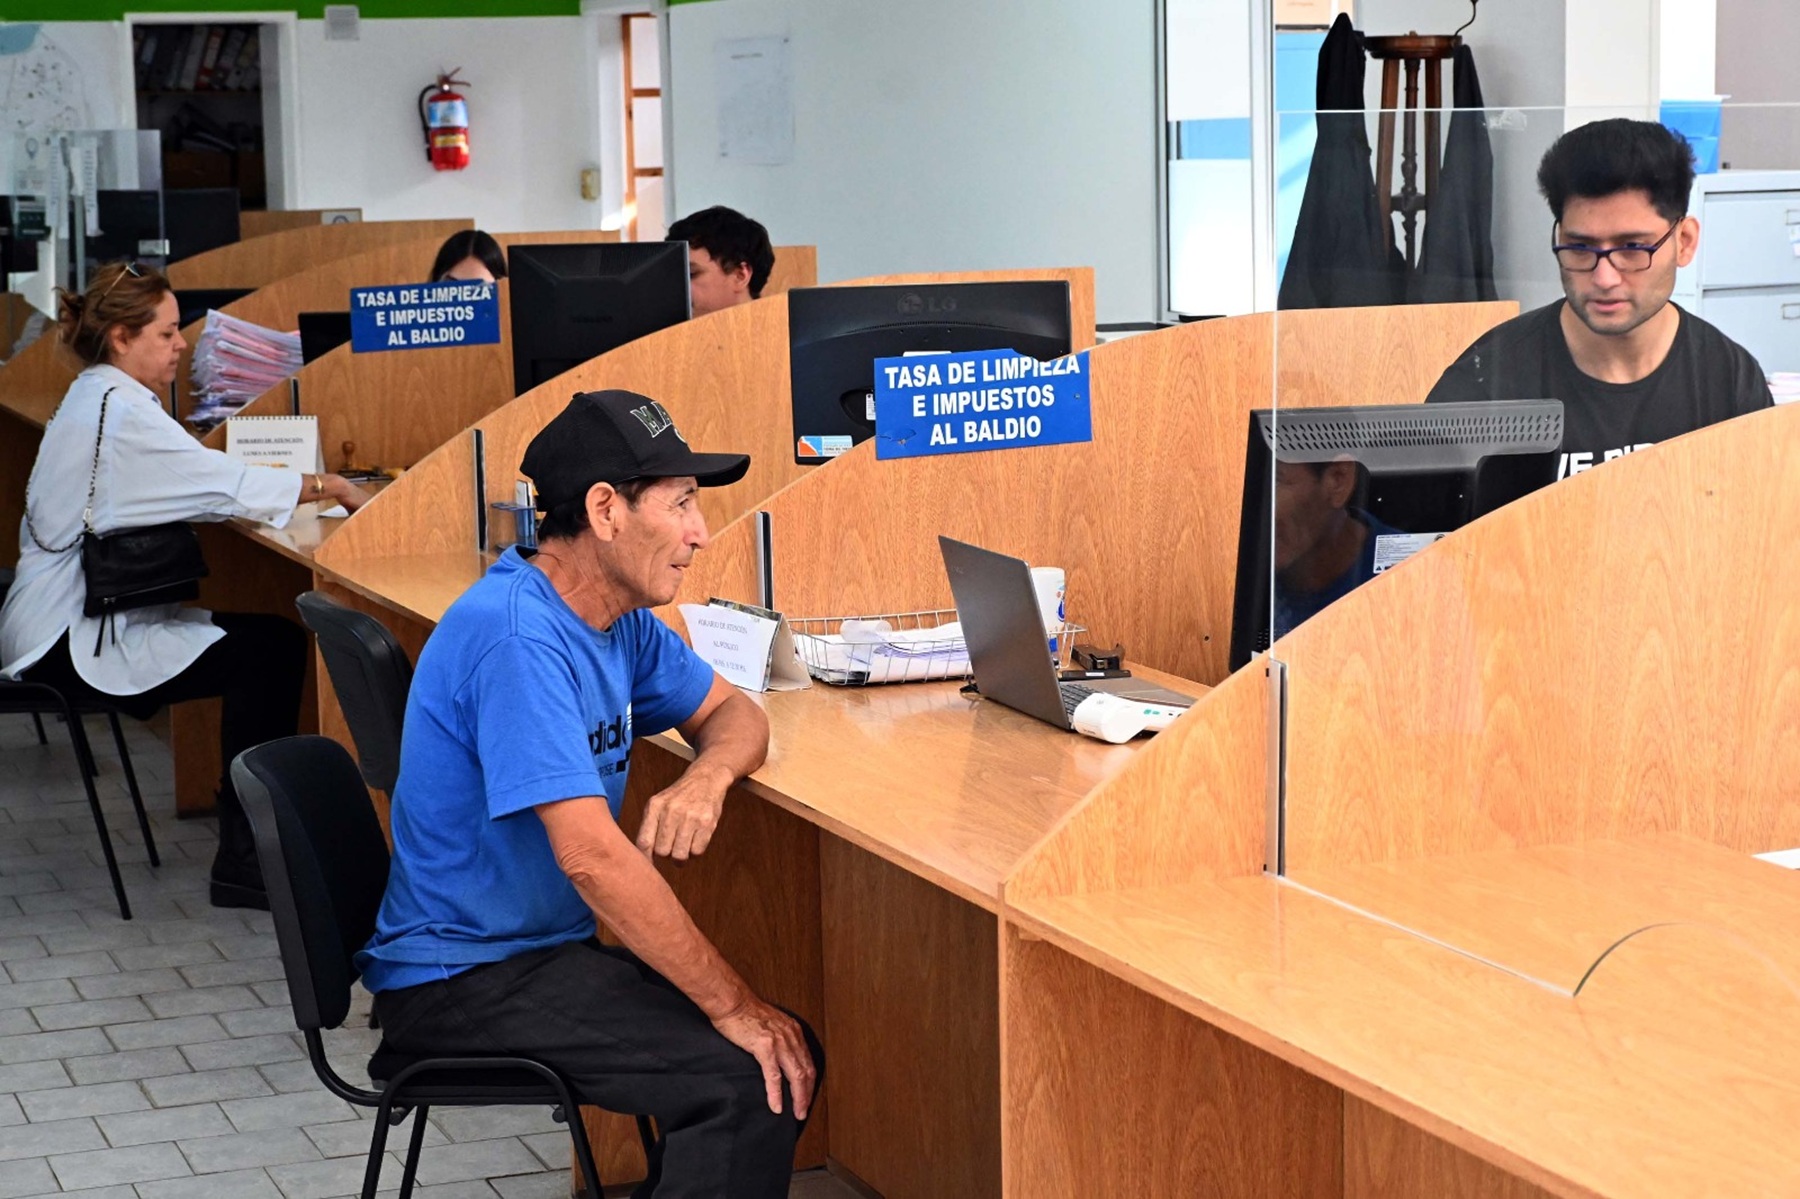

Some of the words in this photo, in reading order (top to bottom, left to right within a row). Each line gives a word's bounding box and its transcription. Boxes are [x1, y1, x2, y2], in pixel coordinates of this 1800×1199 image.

[357, 291, 396, 307] TASA
[400, 289, 420, 305] DE
[423, 285, 492, 304] LIMPIEZA
[376, 311, 386, 326] E
[390, 305, 475, 325] IMPUESTOS
[387, 330, 407, 346] AL
[410, 326, 465, 344] BALDIO
[884, 364, 943, 389] TASA
[948, 361, 976, 385] DE
[912, 395, 927, 417] E
[933, 384, 1055, 415] IMPUESTOS
[929, 423, 958, 446] AL
[963, 415, 1042, 443] BALDIO
